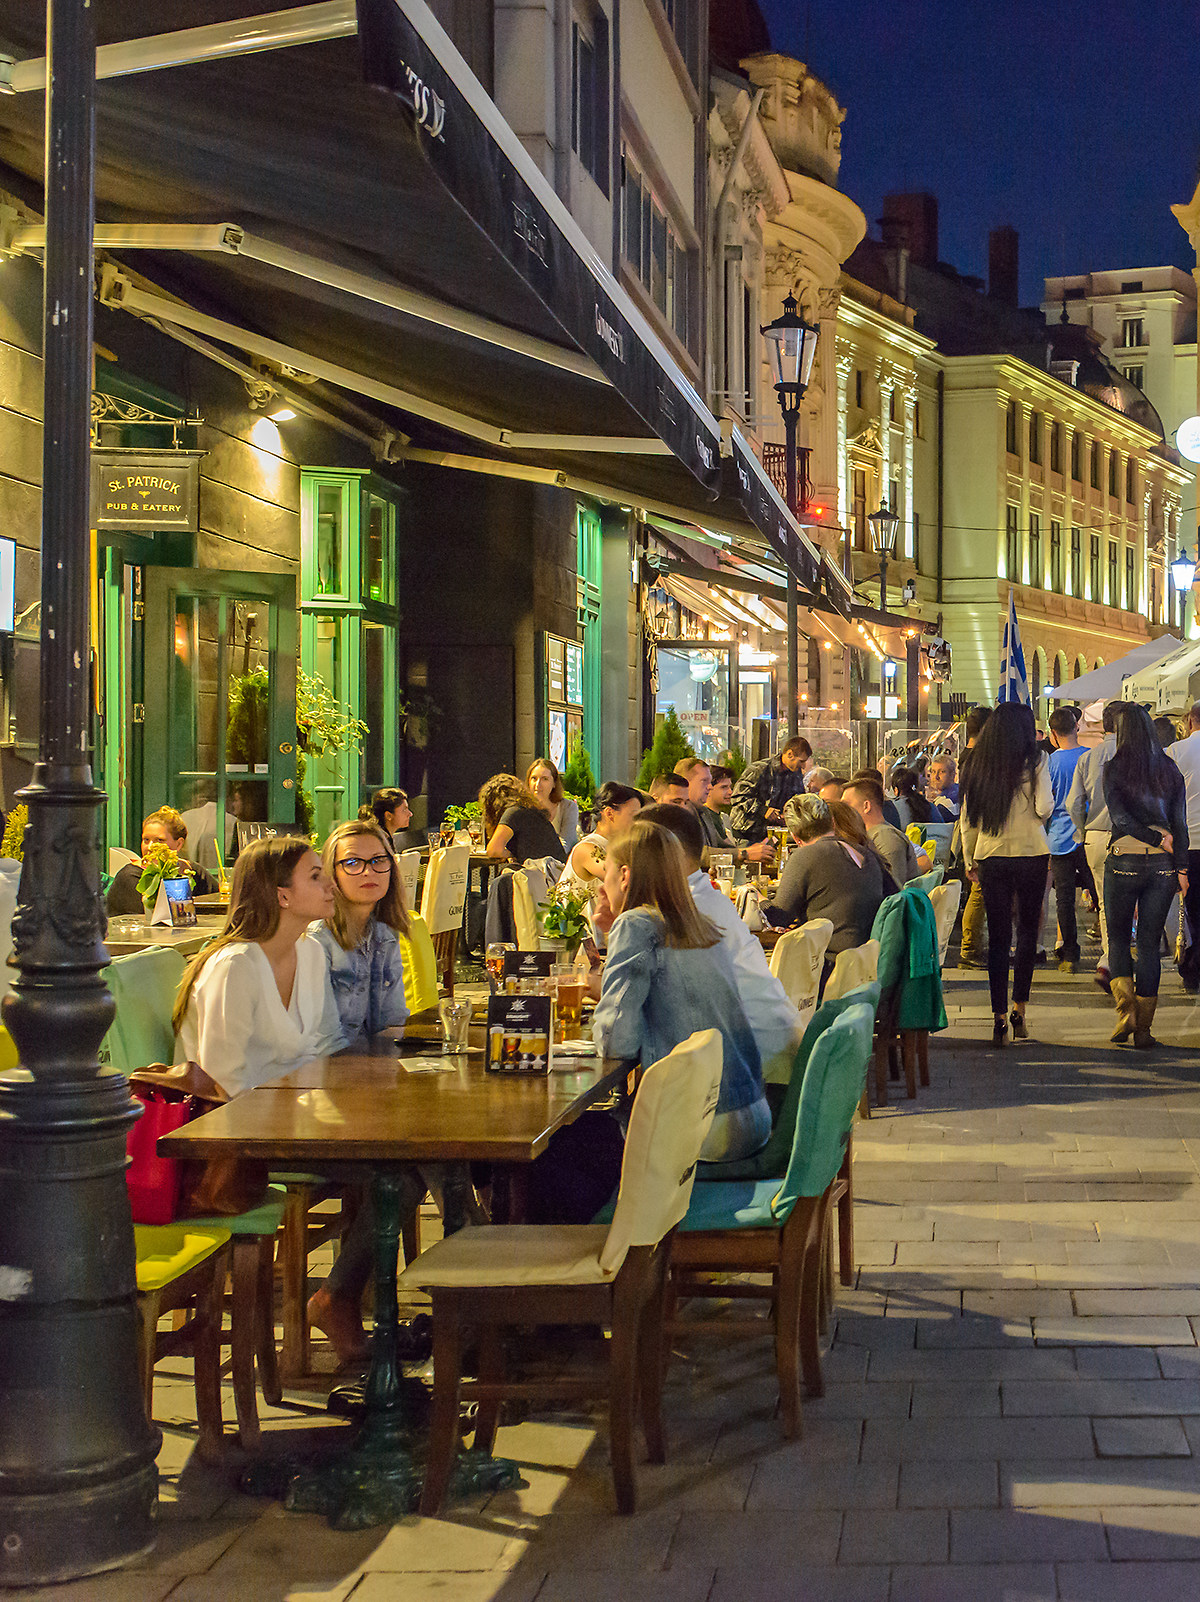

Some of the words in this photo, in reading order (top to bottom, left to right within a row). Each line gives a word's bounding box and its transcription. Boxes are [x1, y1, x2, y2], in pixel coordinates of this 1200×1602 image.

[127, 475, 180, 494] PATRICK
[106, 502, 128, 510] PUB
[130, 502, 139, 511] &
[142, 503, 181, 512] EATERY
[680, 713, 708, 721] OPEN
